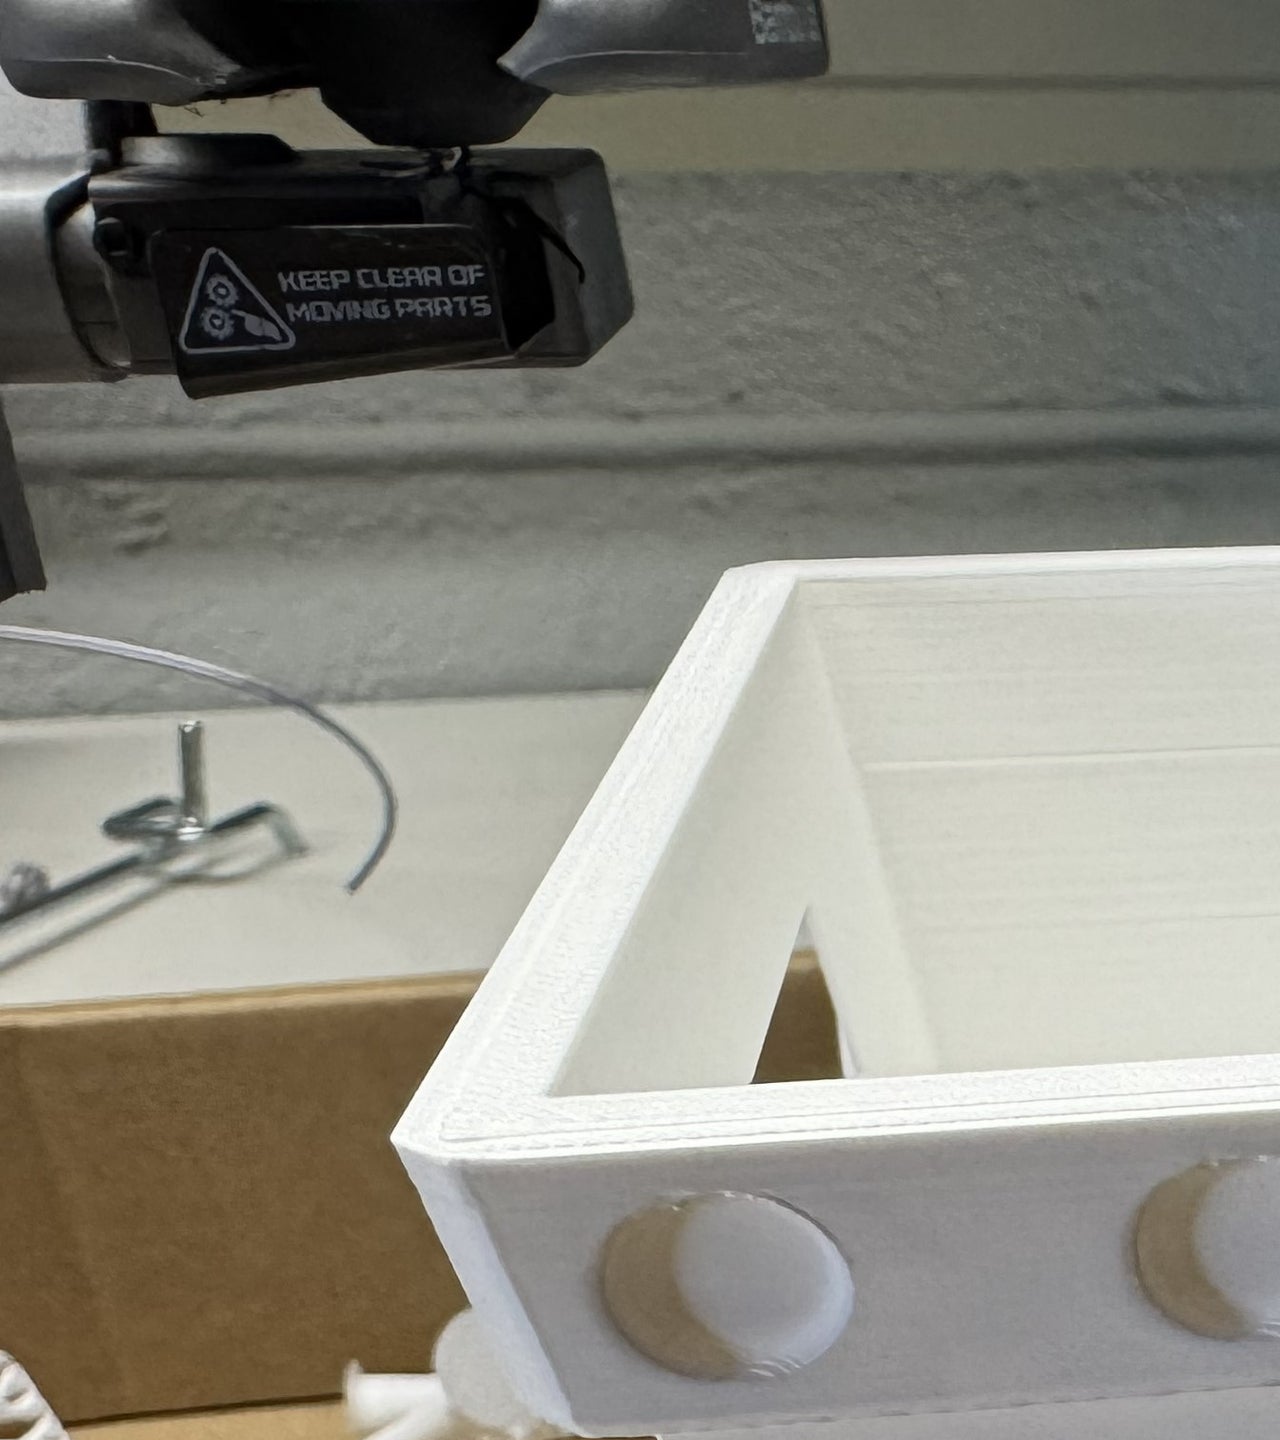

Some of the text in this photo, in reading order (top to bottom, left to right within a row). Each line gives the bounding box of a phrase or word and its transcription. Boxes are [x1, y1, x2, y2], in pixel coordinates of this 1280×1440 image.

[277, 264, 485, 293] KEEP CLEAR OF
[285, 295, 493, 323] MOVING PARTS
